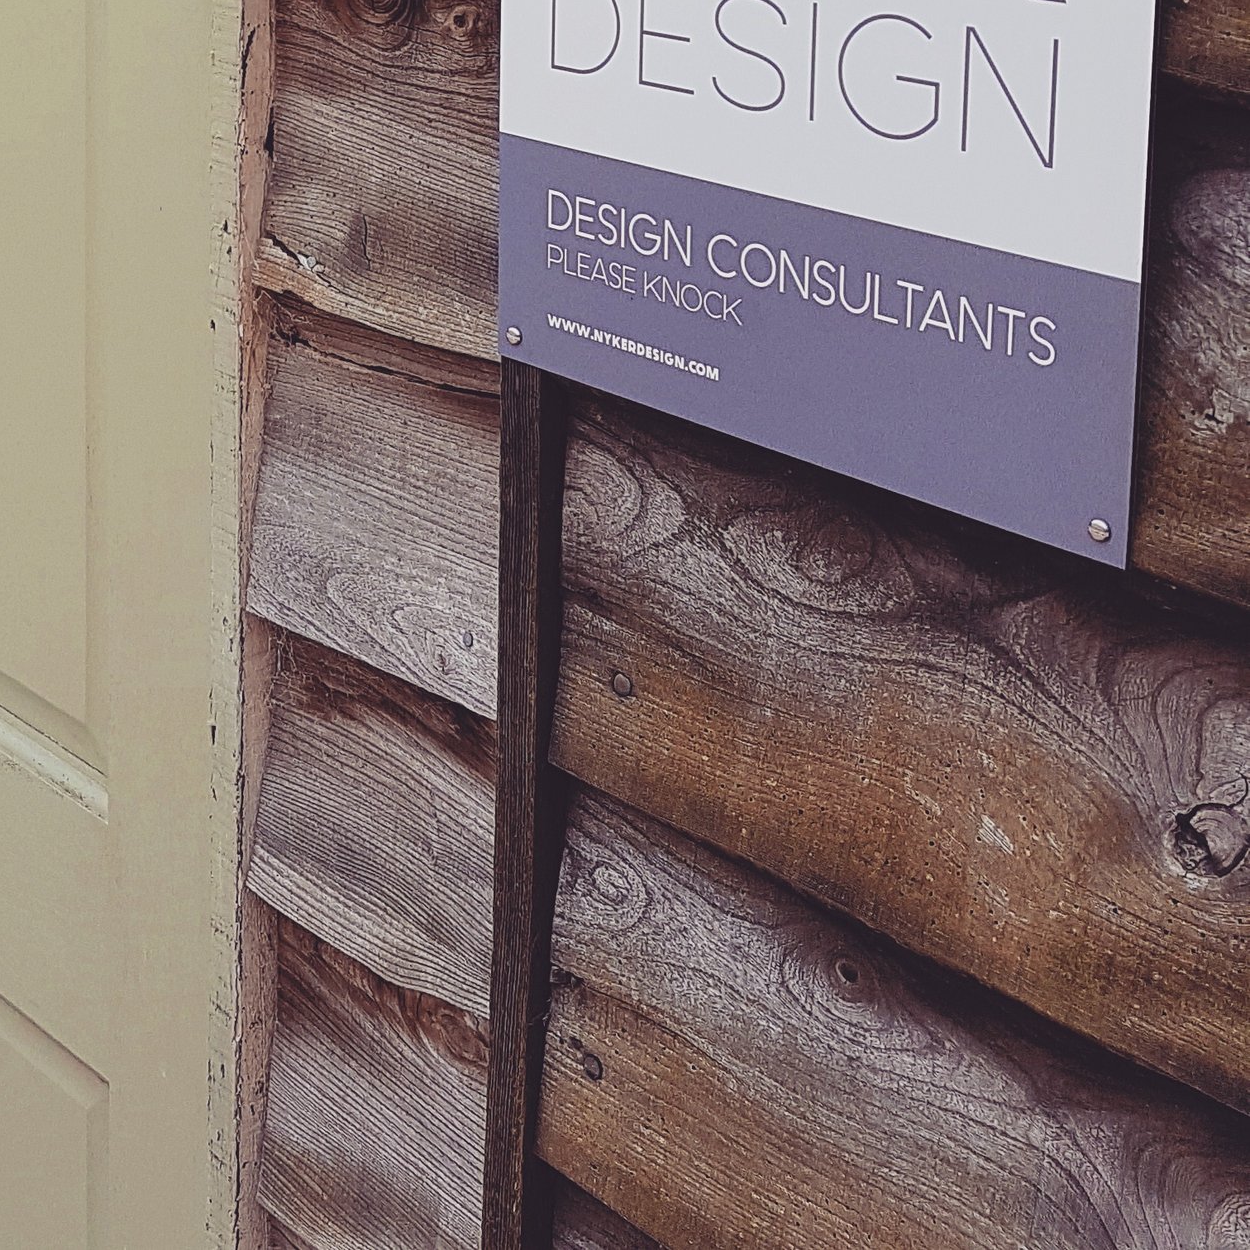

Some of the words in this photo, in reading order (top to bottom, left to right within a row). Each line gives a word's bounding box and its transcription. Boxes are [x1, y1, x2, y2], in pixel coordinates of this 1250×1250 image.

[547, 189, 691, 267] DESIGN
[706, 234, 1056, 367] CONSULTANTS
[547, 244, 636, 295] PLEASE
[643, 269, 744, 326] KNOCK
[547, 313, 720, 381] WWW.NYKERDESIGN.COM
